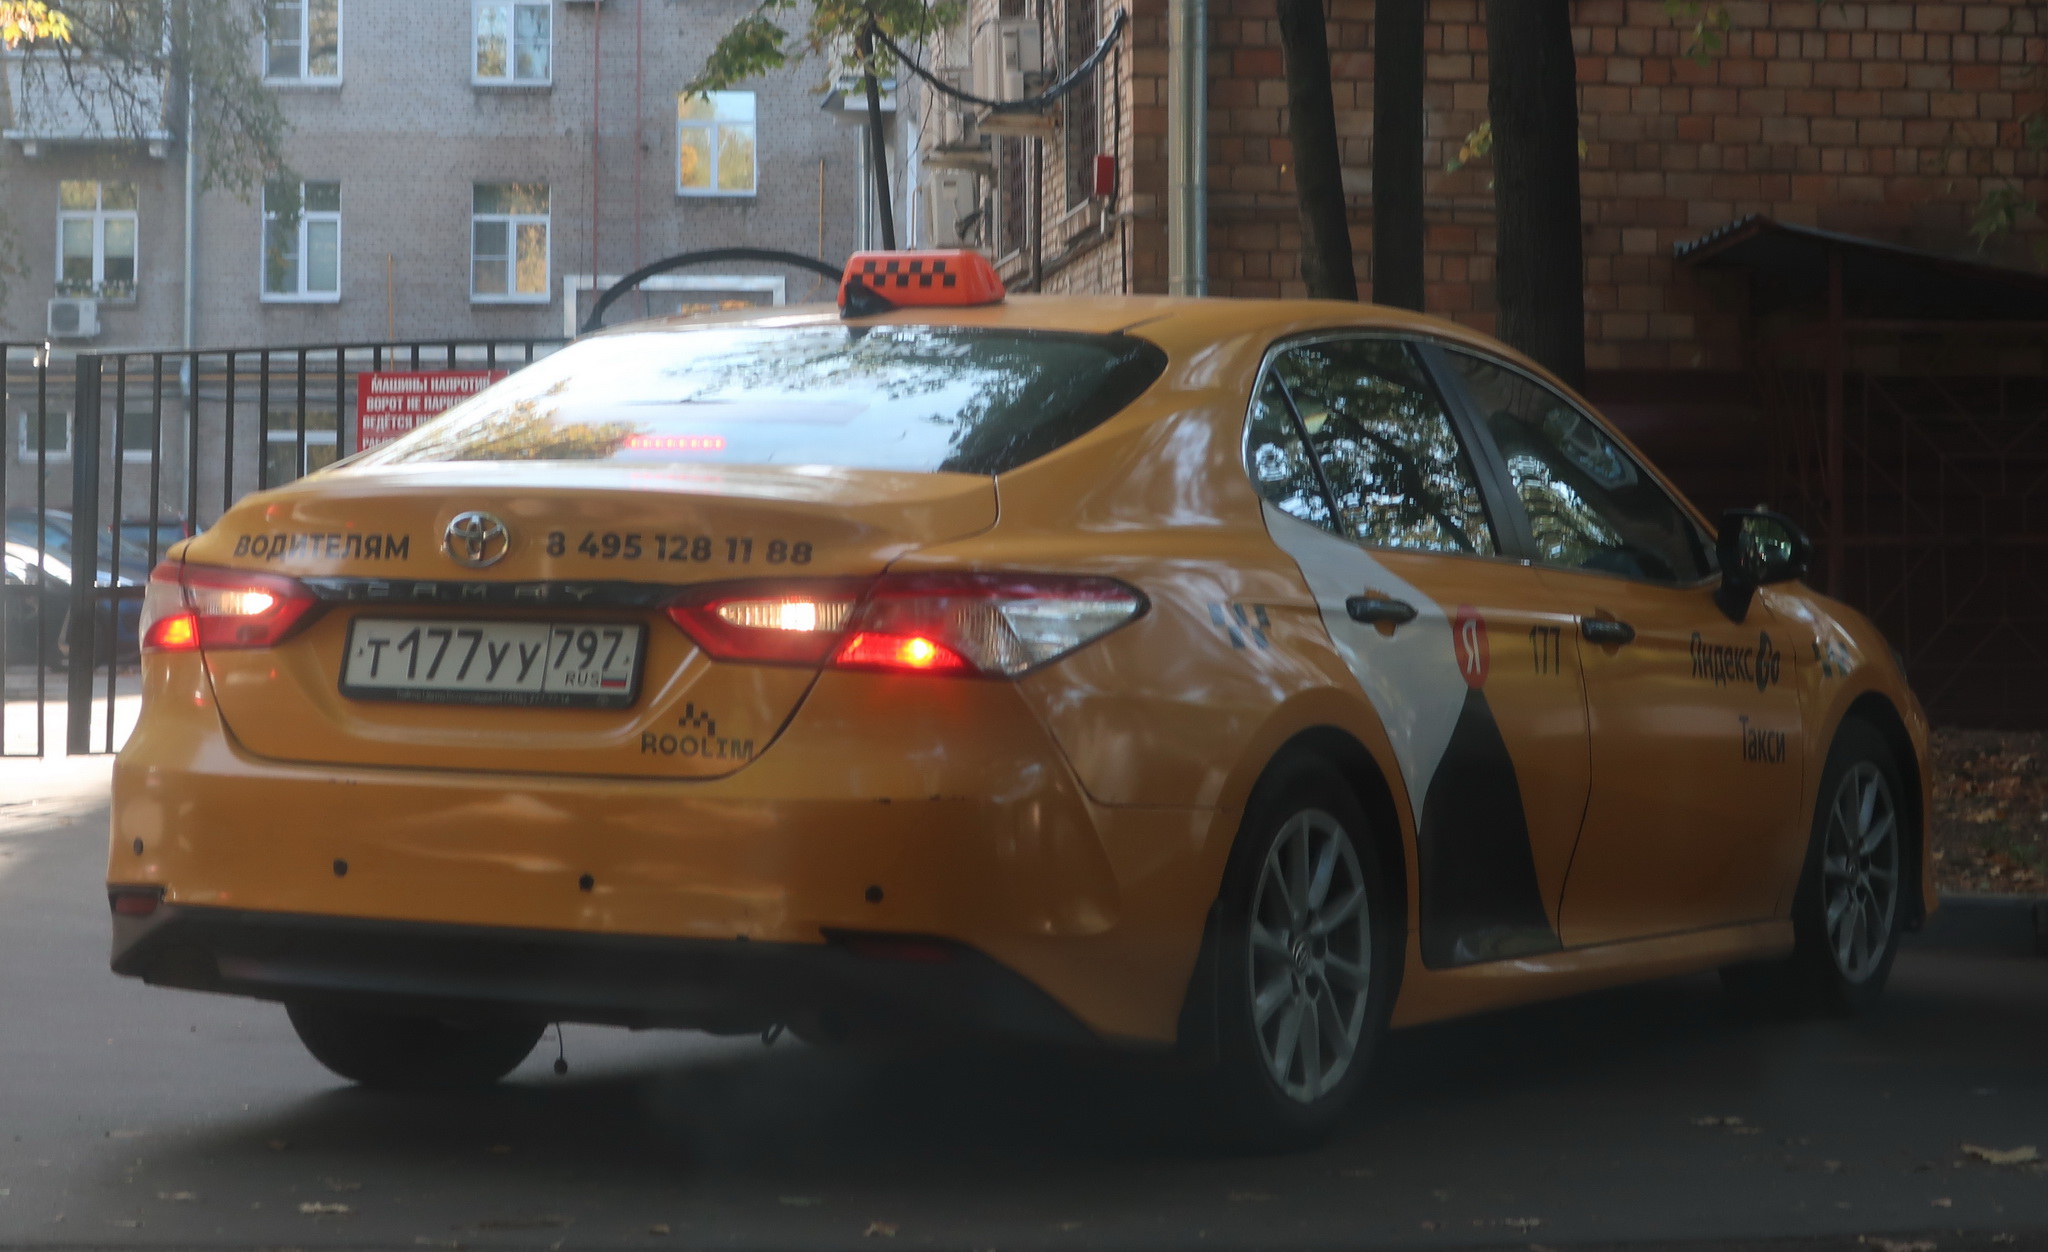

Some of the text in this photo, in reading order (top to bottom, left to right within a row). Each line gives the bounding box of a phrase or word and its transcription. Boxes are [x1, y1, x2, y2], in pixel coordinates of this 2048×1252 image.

[371, 376, 427, 393] МАШИНЫ
[366, 395, 404, 412] ВОРОТ
[406, 395, 420, 411] НЕ
[234, 533, 410, 561] ВОДИТЕЛЯМ
[546, 531, 813, 565] 8 495 128 11 88
[553, 629, 624, 671] 797
[1462, 618, 1481, 675] Я
[1529, 625, 1561, 676] 177
[1690, 631, 1754, 689] Яндекс
[565, 672, 600, 687] RUS
[641, 733, 753, 760] ROOLIM
[1739, 715, 1786, 763] Такси
